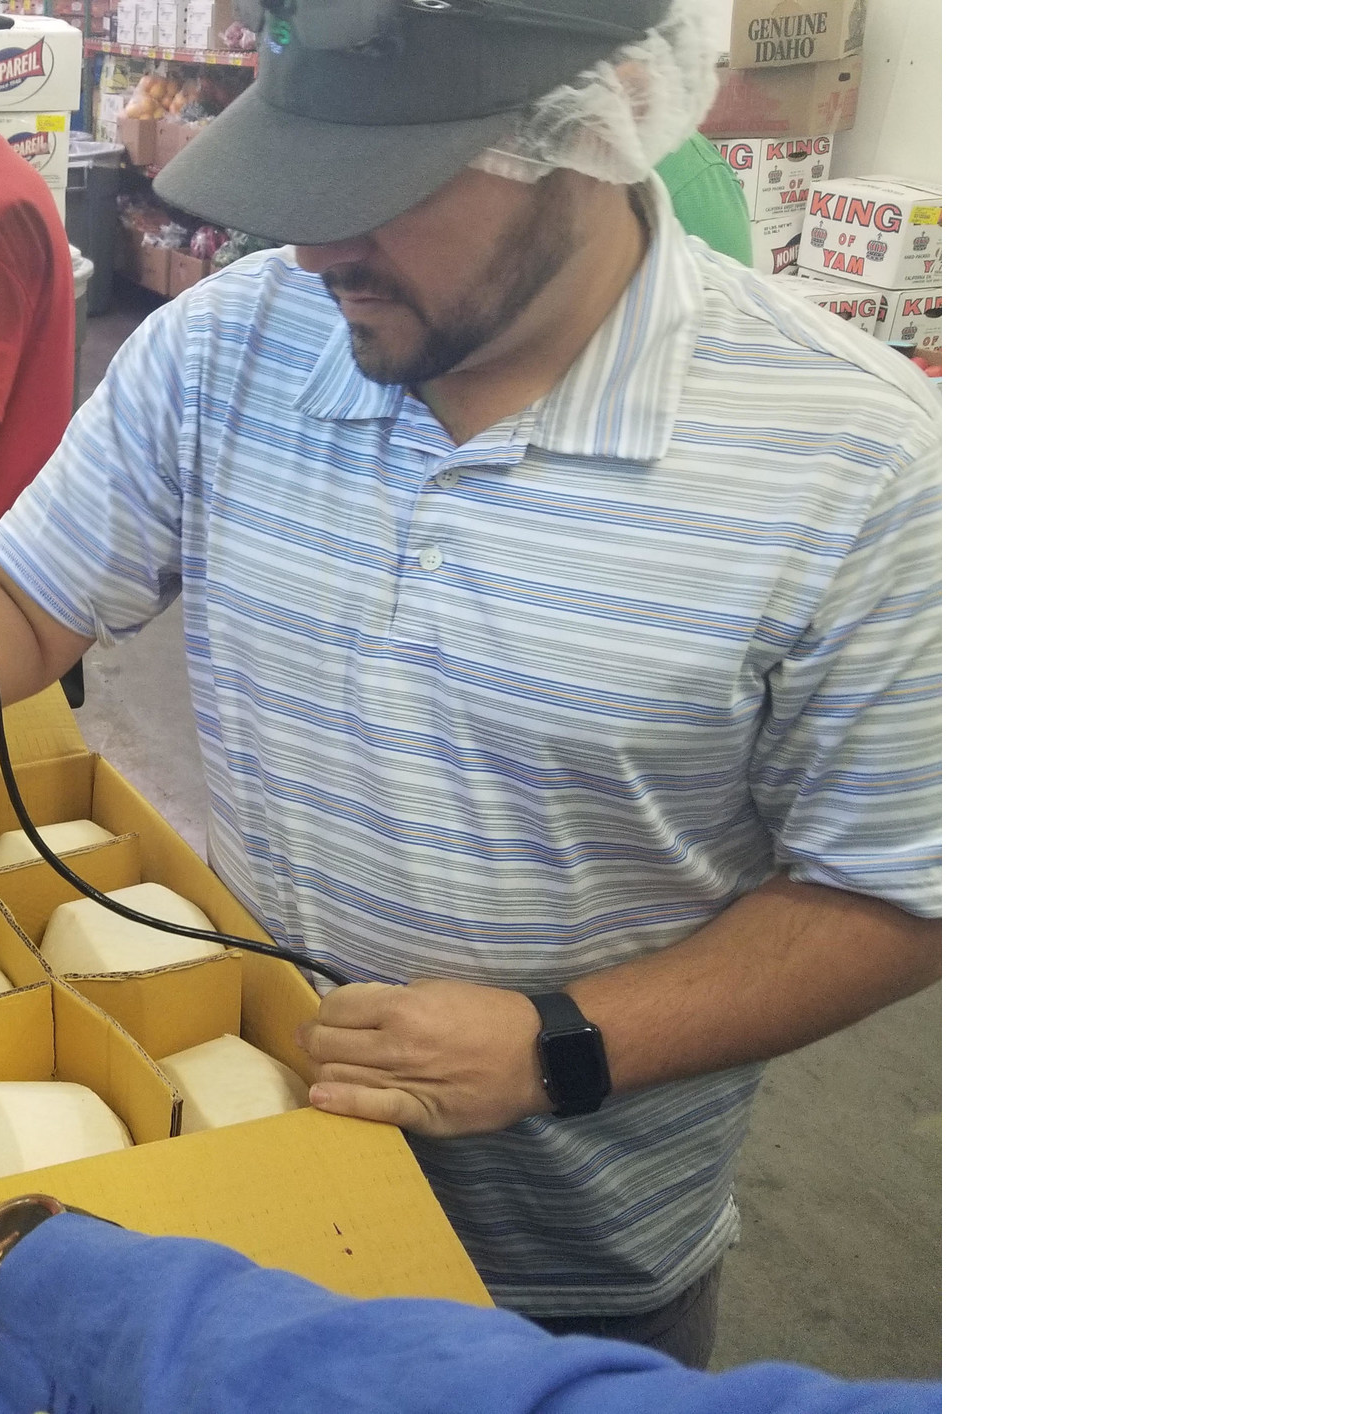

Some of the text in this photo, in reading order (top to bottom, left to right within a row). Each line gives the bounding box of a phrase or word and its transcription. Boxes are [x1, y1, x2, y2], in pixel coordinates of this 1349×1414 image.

[748, 12, 827, 41] GENUINE
[755, 37, 815, 63] IDAHO
[12, 135, 45, 155] PAREIL
[766, 136, 830, 161] KING
[789, 178, 803, 189] OF
[780, 188, 809, 204] YAM
[810, 191, 902, 233] KING
[838, 233, 856, 247] OF
[823, 249, 864, 276] YAM
[923, 336, 939, 346] OF
